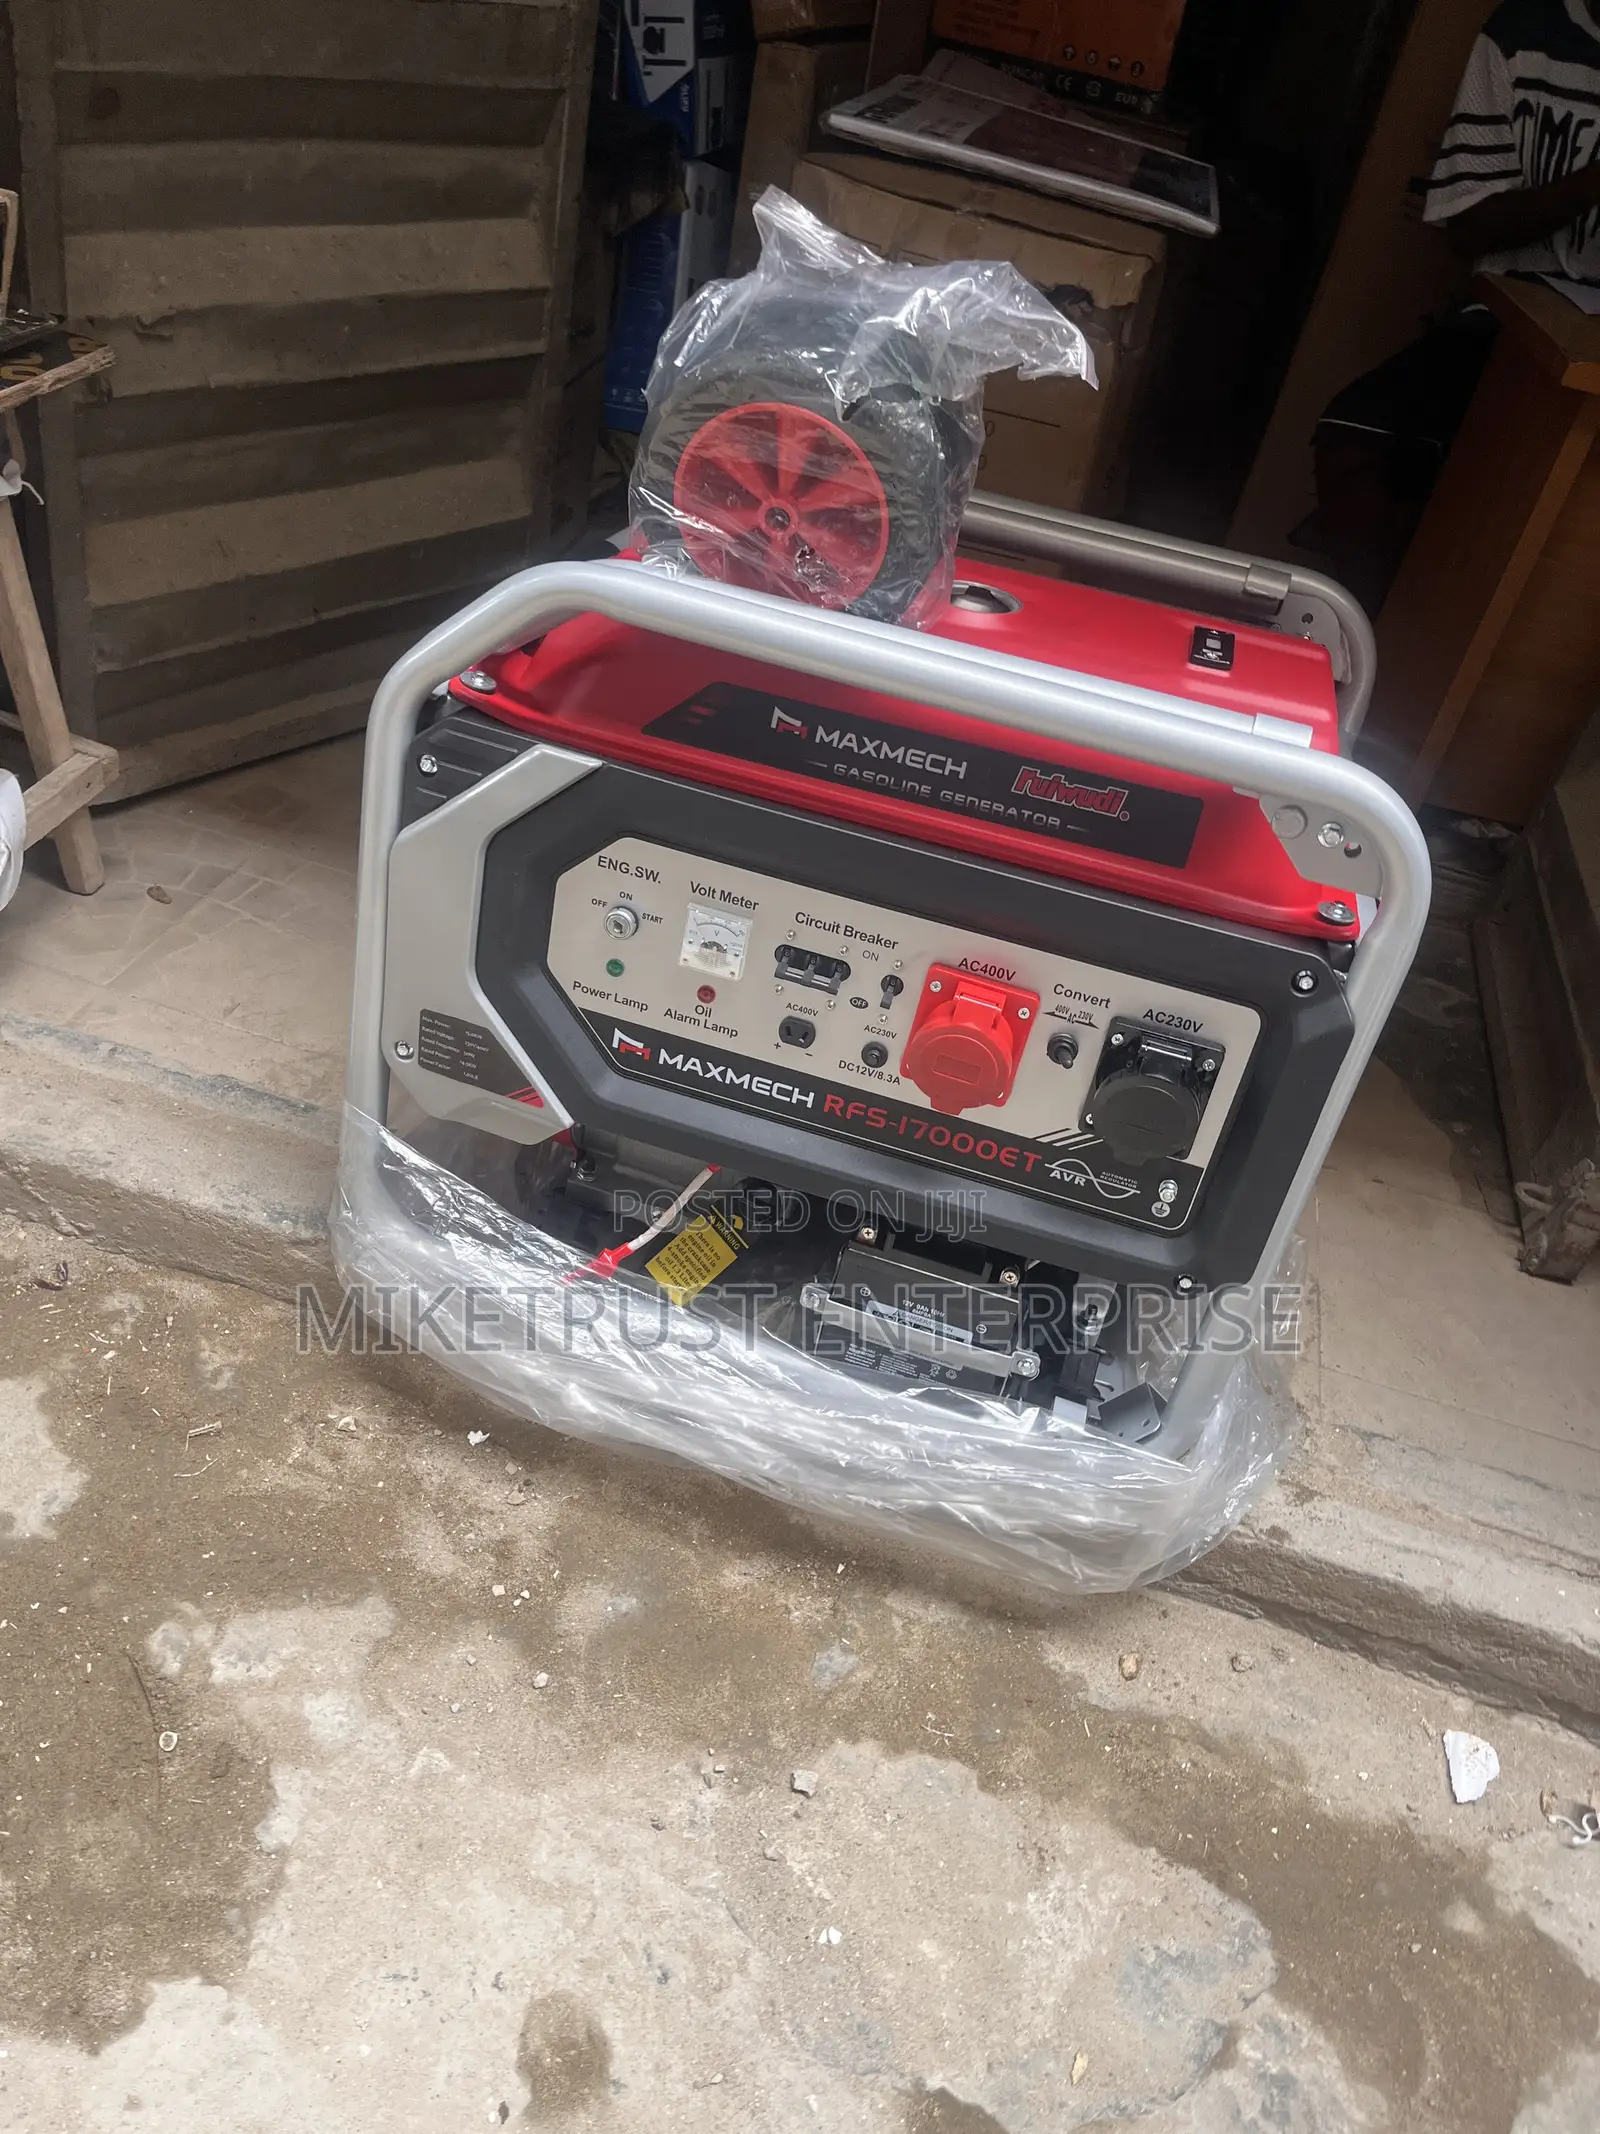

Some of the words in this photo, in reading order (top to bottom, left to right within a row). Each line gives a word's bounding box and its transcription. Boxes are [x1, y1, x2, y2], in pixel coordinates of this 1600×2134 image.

[815, 725, 968, 779] MAXMECH
[833, 763, 932, 798] GASOLINE
[940, 790, 1061, 829] GENERATOR
[597, 855, 662, 884] ENG.SW.
[591, 898, 607, 909] OFF
[619, 891, 633, 901] ON
[690, 881, 717, 900] Volt
[719, 890, 760, 911] Meter
[641, 912, 664, 924] START
[795, 911, 841, 935] Circuit
[843, 924, 899, 950] Breaker
[862, 950, 880, 962] ON
[958, 957, 1016, 982] AC400V
[573, 980, 612, 1001] Power
[614, 993, 649, 1012] Lamp
[851, 999, 867, 1009] OFF
[1053, 983, 1111, 1009] Convert
[695, 1004, 712, 1018] Oil
[785, 1002, 819, 1017] AC400V
[1054, 1004, 1070, 1015] 400V
[1067, 1013, 1077, 1024] AC
[1078, 1011, 1093, 1022] 230V
[1143, 1009, 1204, 1034] AC230V
[664, 1008, 700, 1027] Alarm
[703, 1019, 738, 1039] Lamp
[864, 1025, 897, 1039] AC230V
[838, 1060, 901, 1086] DC12V/8.3A
[658, 1048, 815, 1109] MAXMECH
[823, 1093, 1042, 1172] RFS-17000ET
[1049, 1170, 1086, 1187] AVR
[1100, 1175, 1137, 1189] REGULATOR
[1101, 1171, 1138, 1185] AUTOMATIC
[680, 1236, 688, 1246] the
[687, 1233, 704, 1254] engine
[703, 1252, 711, 1261] oil
[695, 1231, 710, 1247] There
[713, 1252, 721, 1260] no
[715, 1220, 740, 1250] WARNING
[655, 1256, 671, 1275] before
[664, 1256, 673, 1265] oil
[674, 1243, 686, 1256] Add
[683, 1254, 706, 1280] specified
